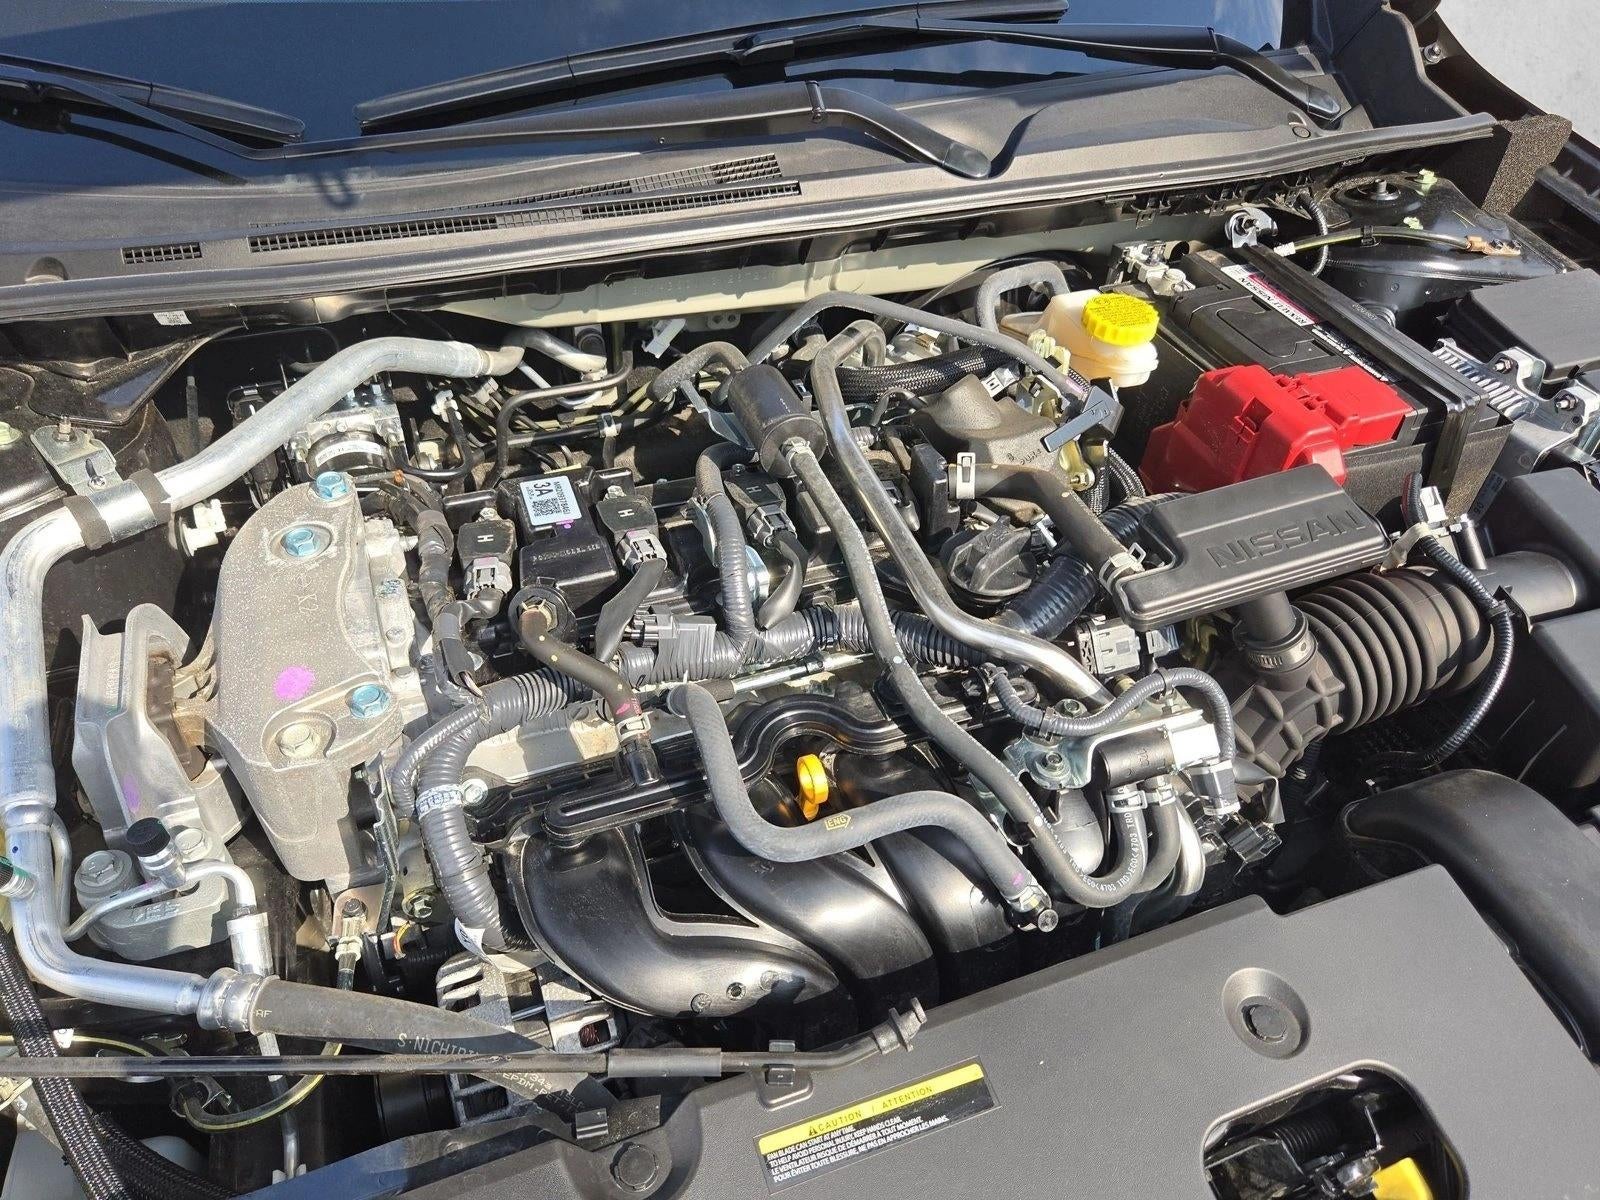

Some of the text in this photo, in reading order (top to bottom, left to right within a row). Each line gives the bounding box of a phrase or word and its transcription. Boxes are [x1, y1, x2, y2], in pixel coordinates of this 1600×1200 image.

[533, 481, 554, 498] 3A
[617, 508, 635, 518] H
[477, 534, 494, 543] H
[1206, 510, 1366, 568] NISSAN
[828, 815, 847, 827] ENG
[817, 1109, 863, 1132] CAUTION
[880, 1084, 933, 1109] ATTENTION
[768, 1159, 779, 1168] TO
[777, 1154, 792, 1165] HELP
[790, 1148, 810, 1160] AVOID
[807, 1139, 836, 1154] PERSONAL
[852, 1127, 868, 1139] KEEP
[865, 1121, 885, 1133] HANDS
[770, 1166, 780, 1176] LE
[777, 1153, 818, 1173] VENTILATEUR
[815, 1145, 839, 1160] RISQUE
[836, 1142, 847, 1152] DE
[845, 1131, 877, 1148] DÉMARRER
[880, 1124, 897, 1136] TOUT
[772, 1170, 792, 1183] POUR
[789, 1162, 811, 1177] ÉVITER
[809, 1156, 830, 1170] TOUTE
[857, 1143, 868, 1153] NE
[865, 1139, 878, 1149] PAS
[876, 1135, 887, 1145] EN
[884, 1124, 920, 1142] APPROCHER
[917, 1120, 930, 1130] LES
[777, 1144, 796, 1157] BLADE
[794, 1140, 808, 1151] CAN
[806, 1134, 824, 1146] START
[822, 1132, 832, 1141] AT
